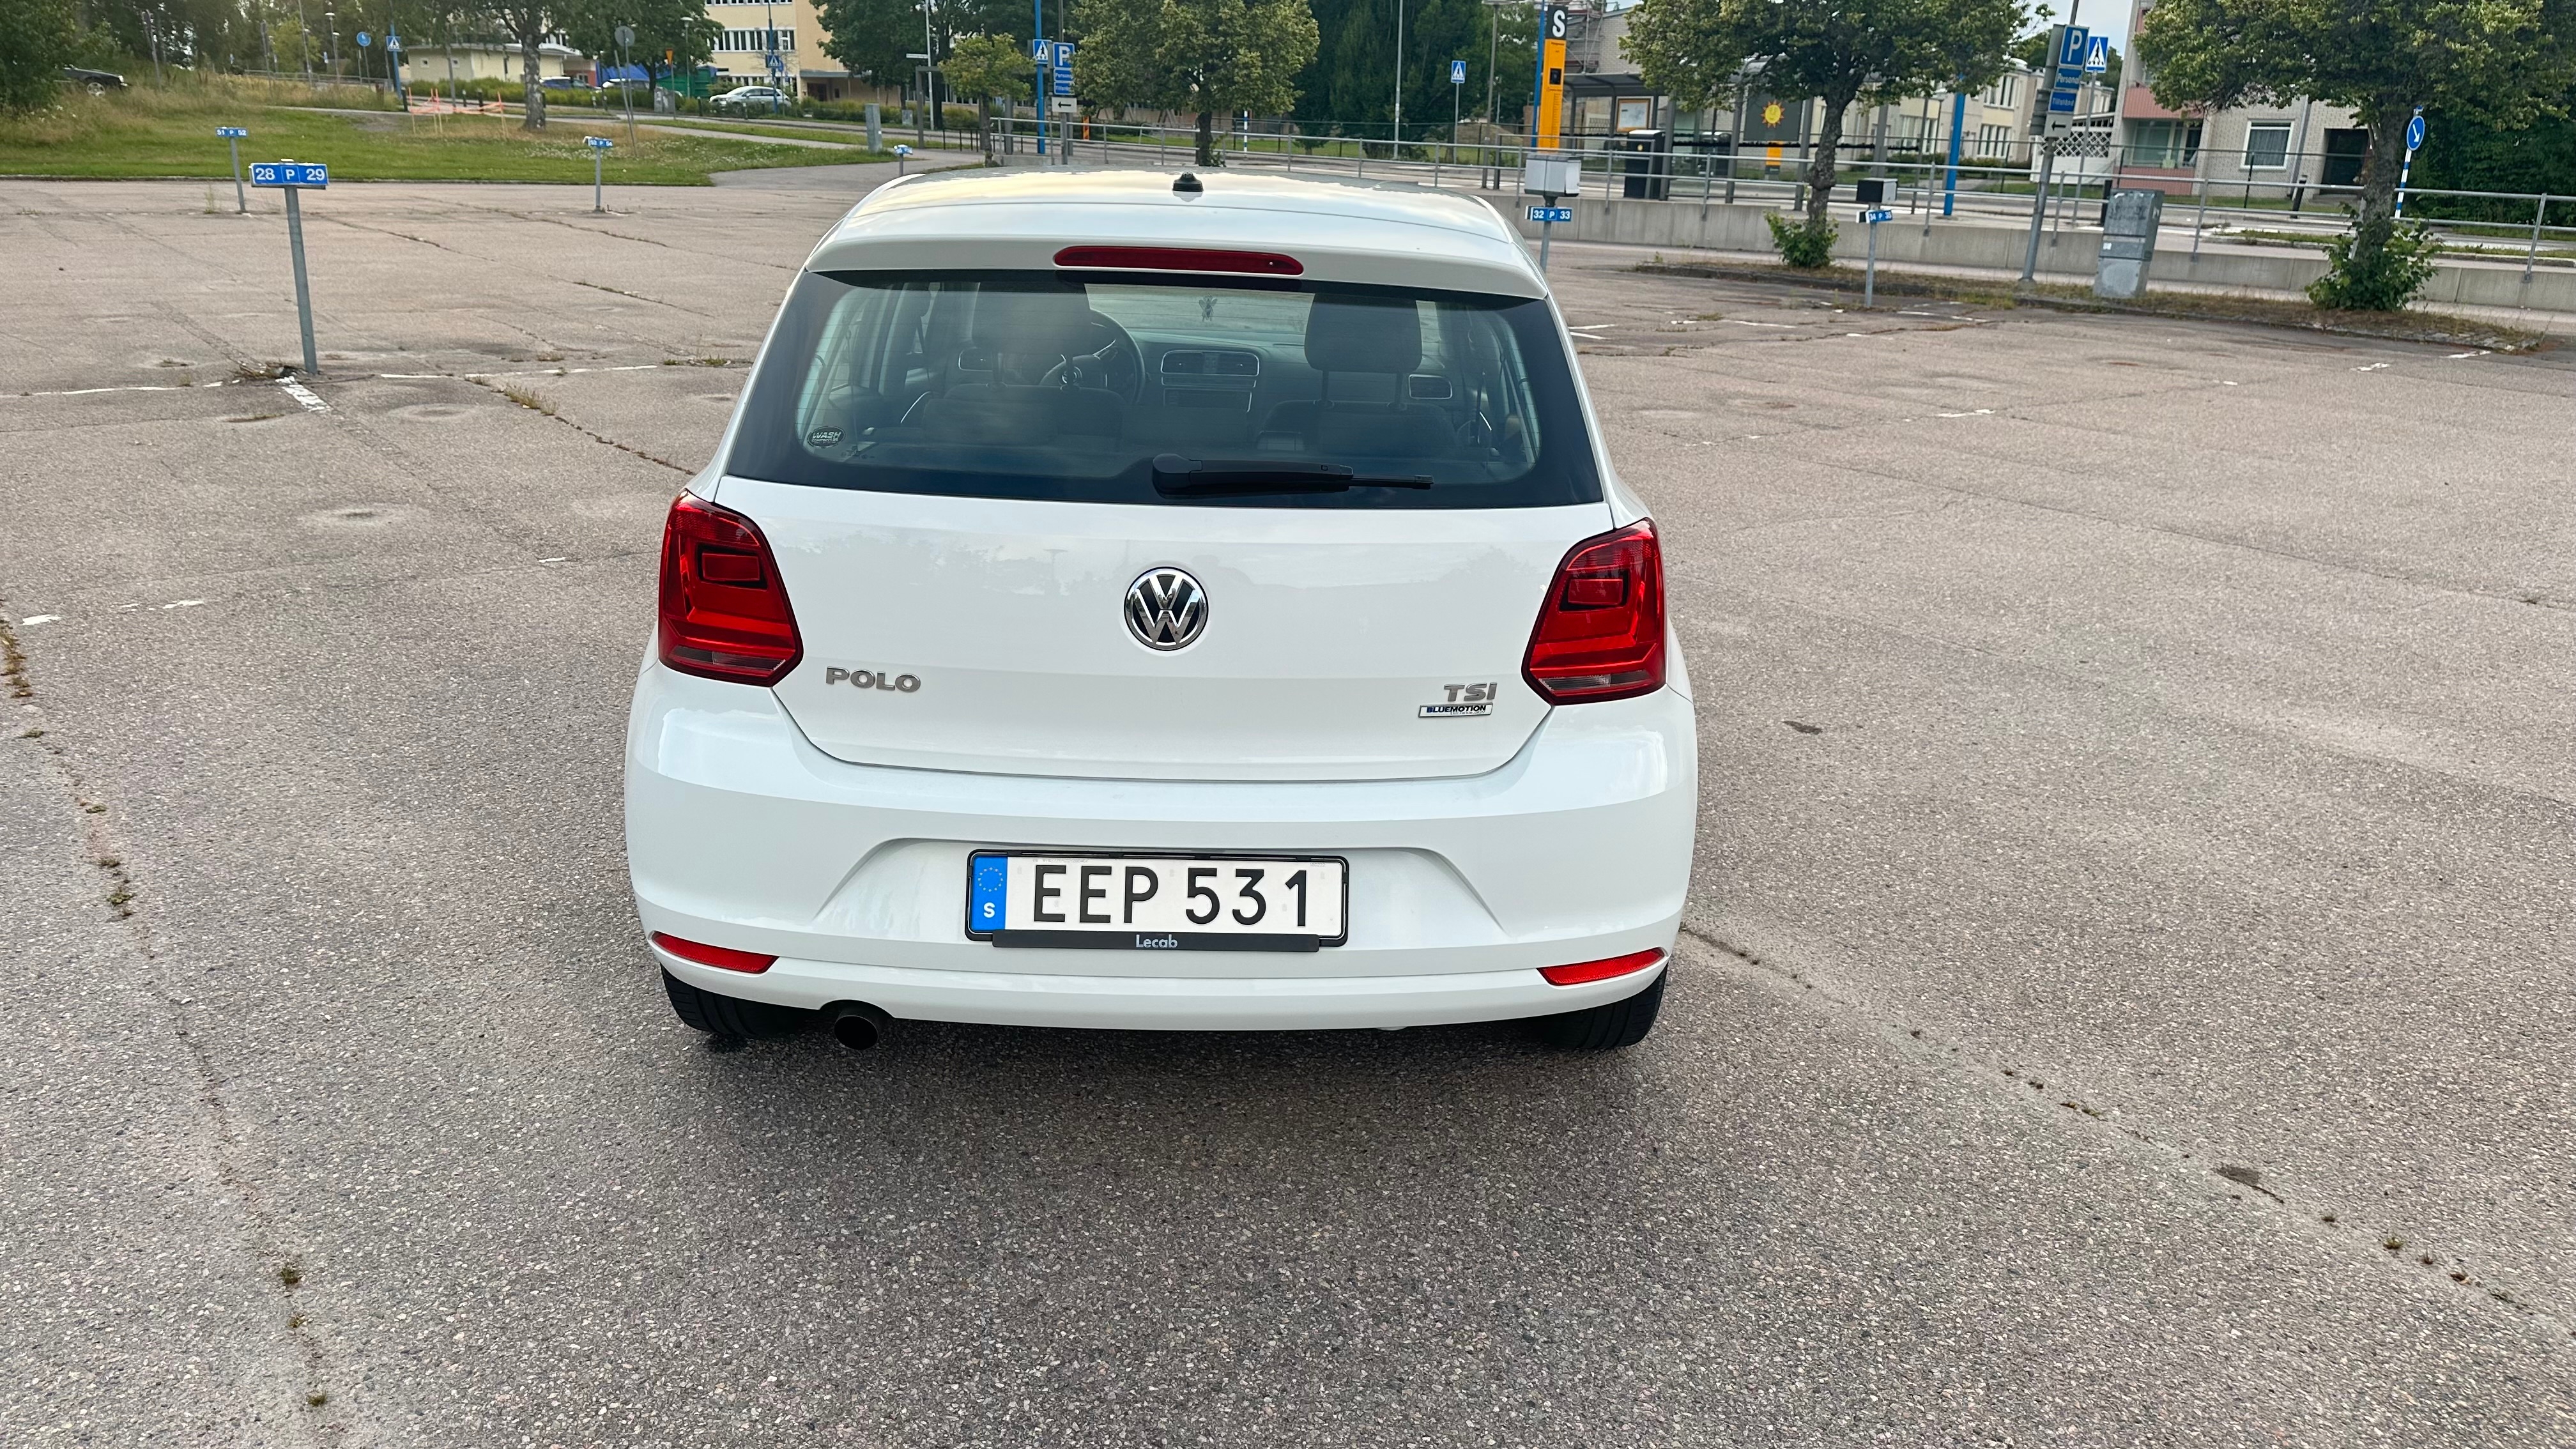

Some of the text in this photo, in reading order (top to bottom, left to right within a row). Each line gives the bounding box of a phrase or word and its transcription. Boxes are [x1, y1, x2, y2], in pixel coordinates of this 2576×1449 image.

[1552, 10, 1566, 38] S
[1059, 45, 1071, 66] P
[2067, 29, 2083, 62] P
[255, 167, 325, 181] 28 P 29
[1533, 210, 1544, 218] 32
[1560, 210, 1570, 219] 33
[812, 431, 842, 440] WASH
[1126, 568, 1207, 649] VW
[825, 666, 921, 693] POLO
[1443, 682, 1498, 702] TSI
[1426, 705, 1487, 714] BLUEMOTION
[1033, 864, 1307, 927] EEP 531
[983, 901, 996, 919] S
[1135, 933, 1179, 948] Lecab
